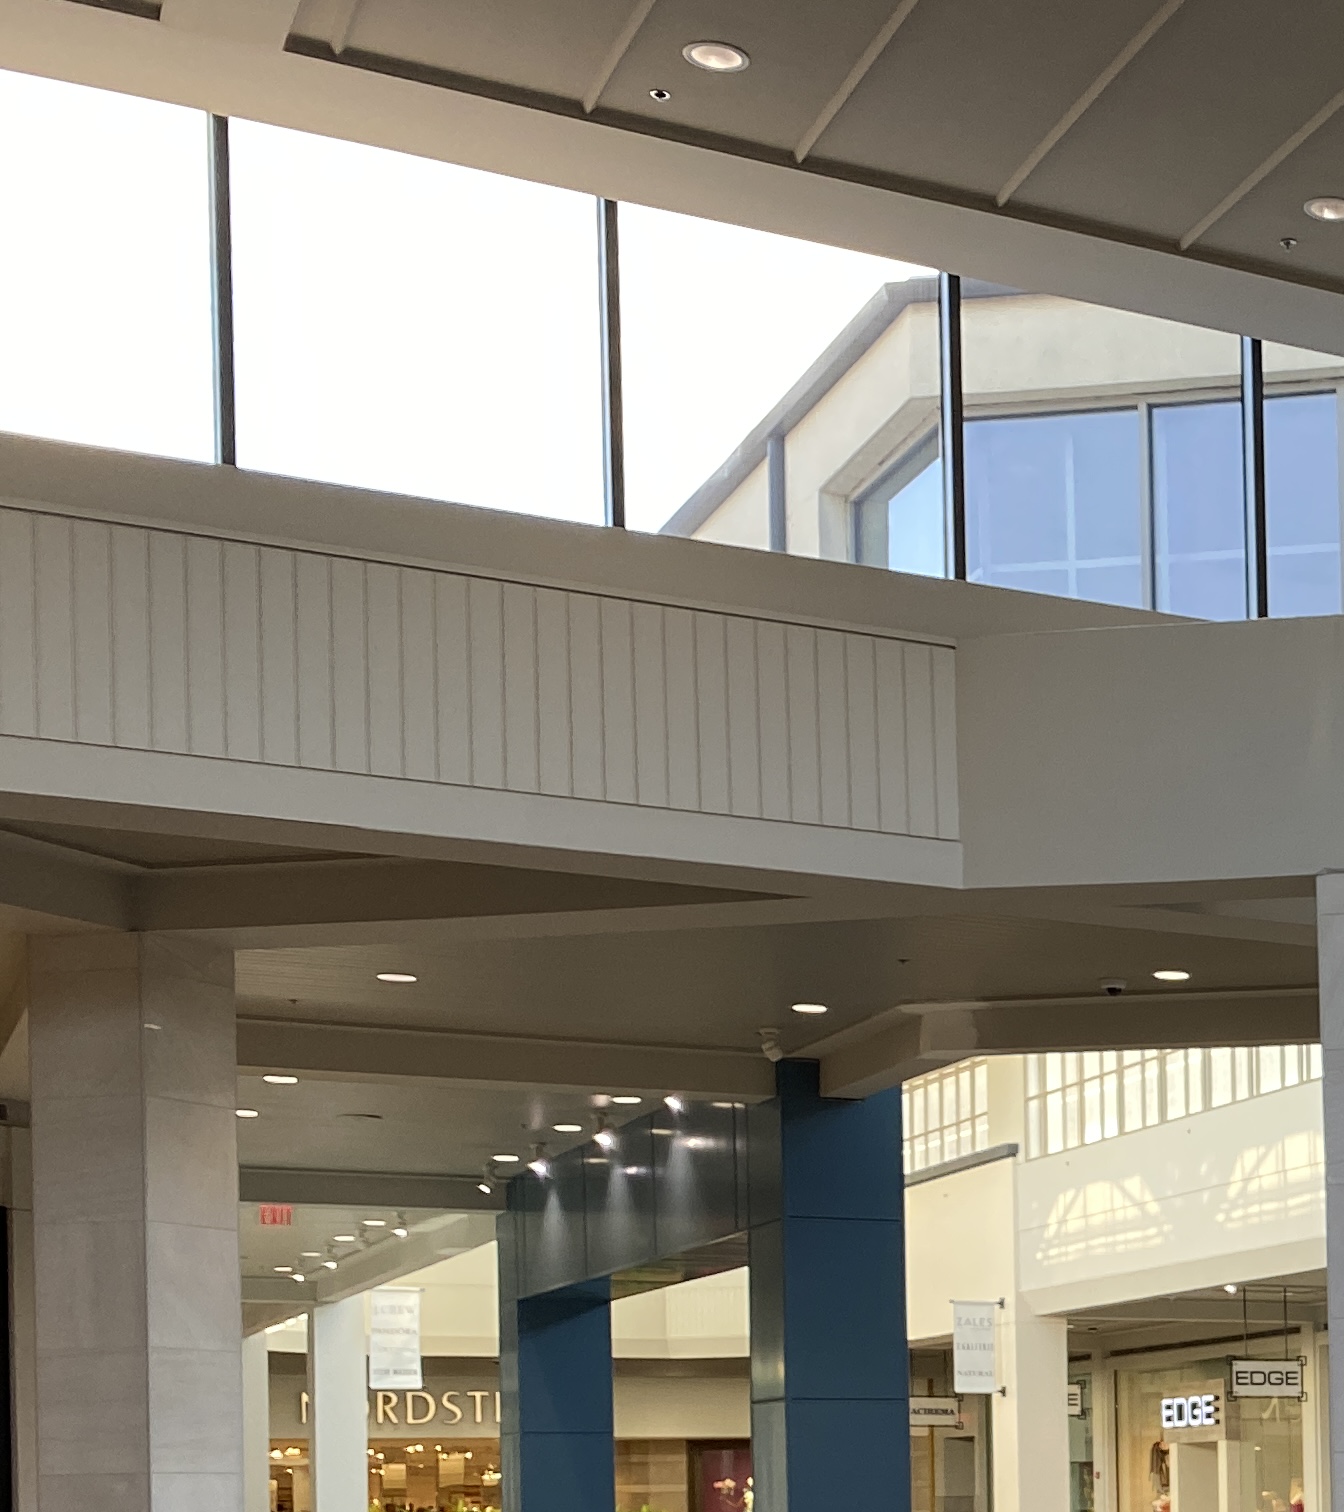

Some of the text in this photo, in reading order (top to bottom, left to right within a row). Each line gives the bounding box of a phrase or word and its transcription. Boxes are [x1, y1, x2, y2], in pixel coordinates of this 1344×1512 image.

[956, 1316, 993, 1328] ZALES
[1236, 1369, 1300, 1387] EDGE
[1161, 1393, 1217, 1429] EDGE
